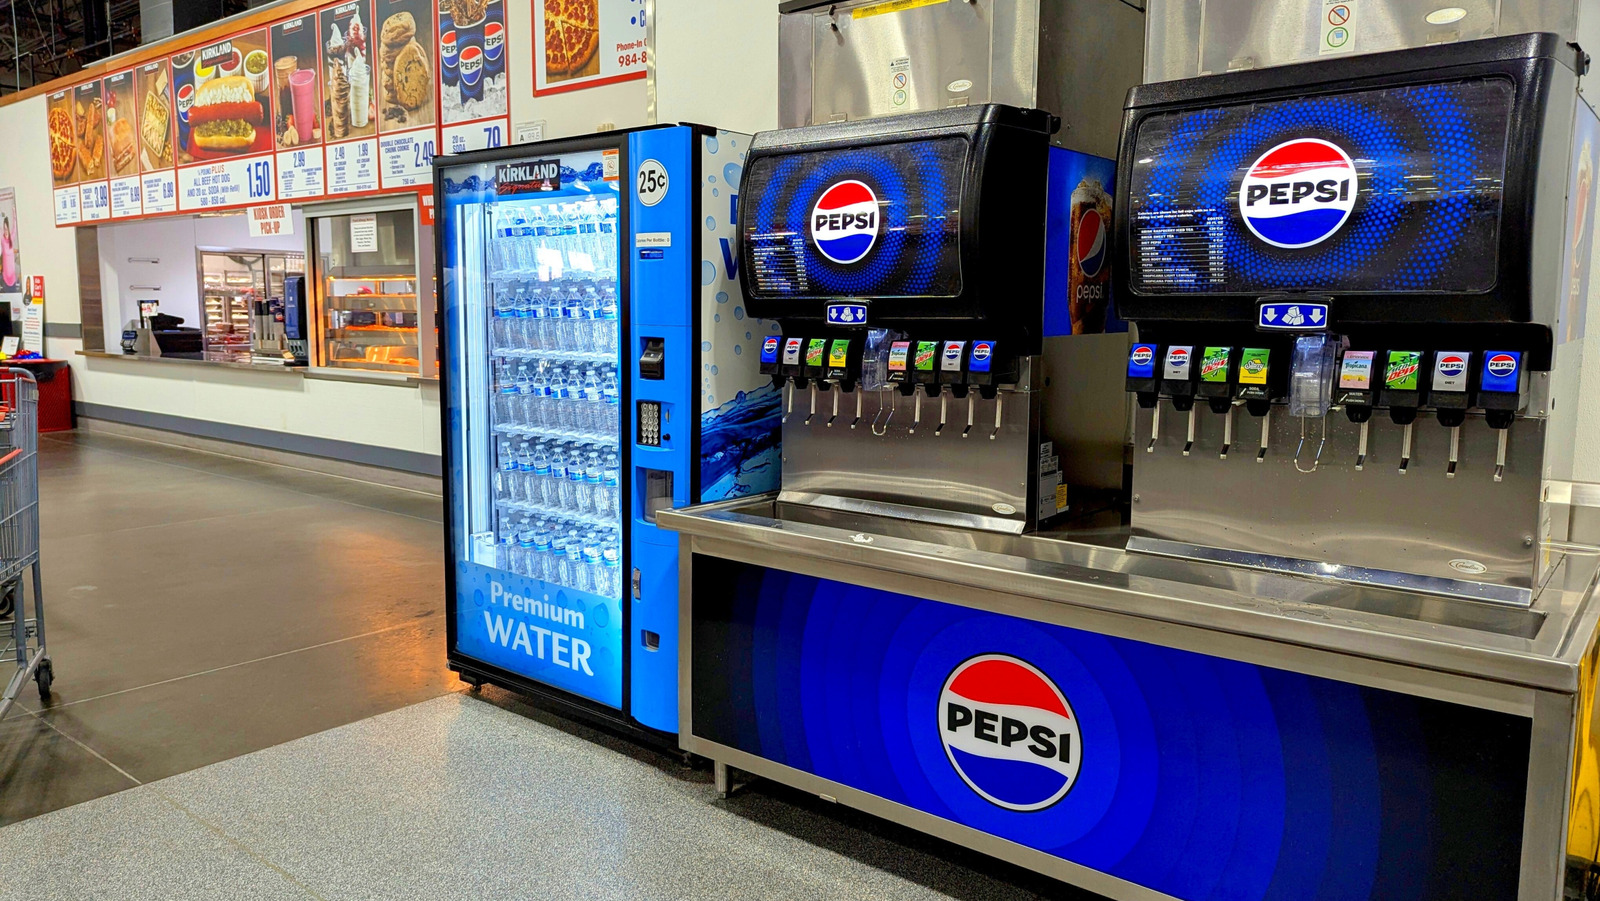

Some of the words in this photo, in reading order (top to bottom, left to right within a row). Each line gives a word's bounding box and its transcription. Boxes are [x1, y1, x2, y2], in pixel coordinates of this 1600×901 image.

[202, 42, 232, 61] KIRKLAND
[616, 40, 642, 52] Phone-In
[618, 51, 647, 67] 984-8
[395, 137, 414, 145] CHOCOLATE
[452, 143, 466, 153] SODA
[293, 151, 305, 168] 2.99
[414, 140, 434, 168] 2.49
[212, 164, 225, 173] PLUS
[499, 163, 559, 184] KIRKLAND
[202, 176, 211, 184] BEEF
[212, 175, 220, 183] HOT
[221, 173, 230, 182] DOG
[247, 161, 270, 198] 1.50
[639, 169, 666, 194] 25¢
[94, 185, 107, 208] 3.99
[187, 189, 195, 197] AND
[208, 185, 219, 195] SODA
[1247, 178, 1350, 206] PEPSI
[269, 205, 285, 218] ORDER
[260, 221, 280, 235] PICK-UP
[815, 212, 875, 232] PEPSI
[1076, 282, 1103, 303] pepsi
[1345, 361, 1368, 369] Tropicana
[490, 581, 584, 630] Premium
[483, 611, 594, 677] WATER
[947, 702, 1071, 764] PEPSI
